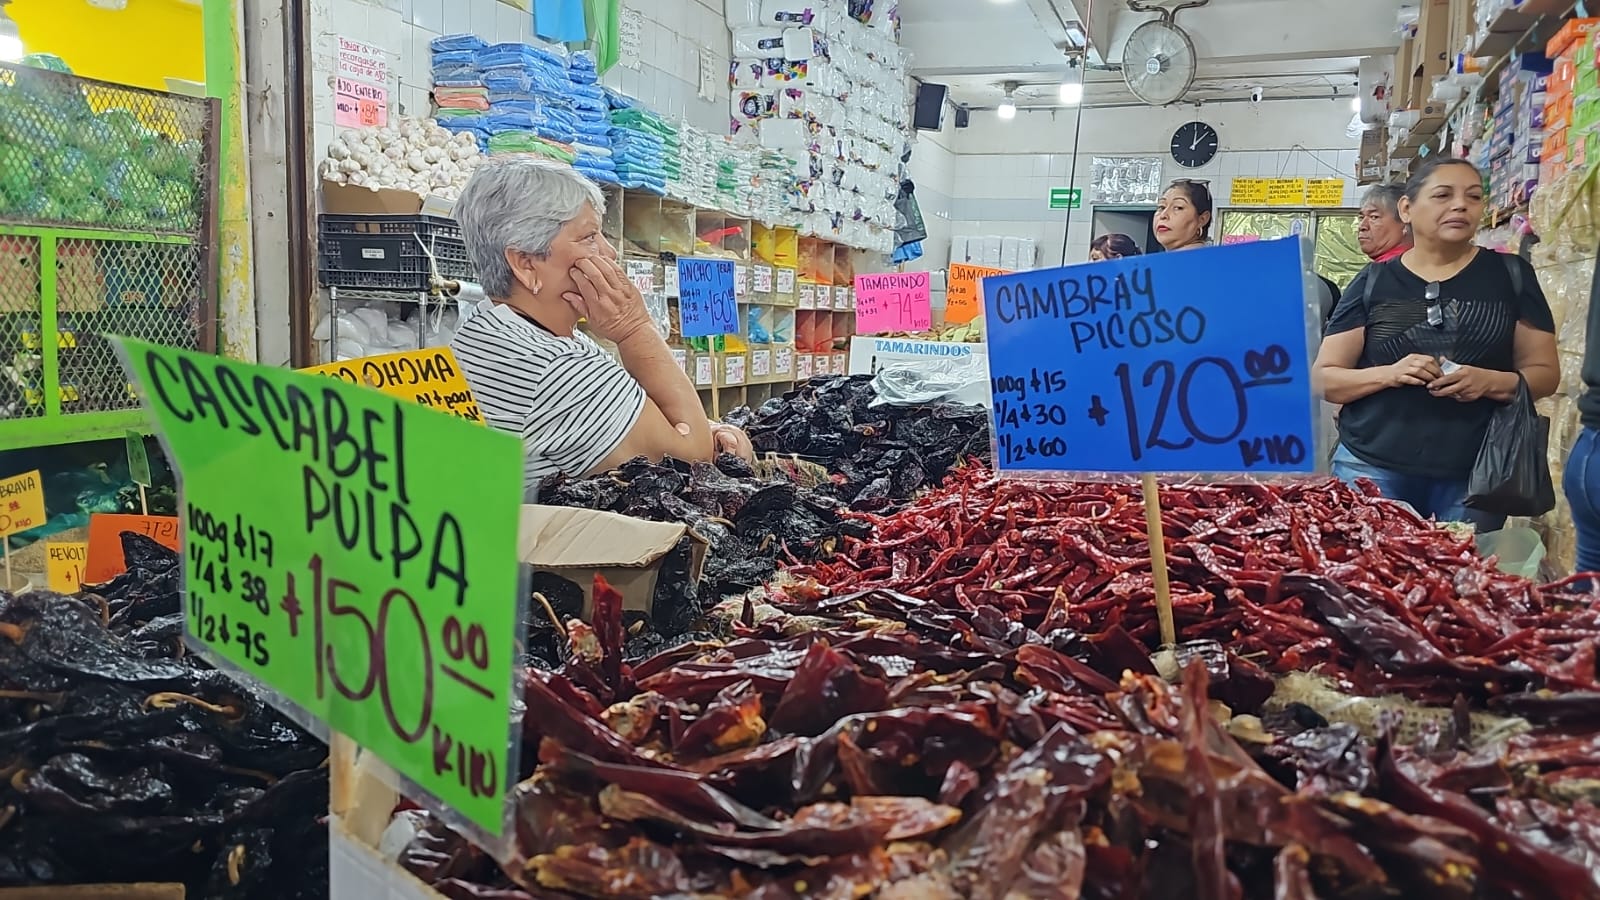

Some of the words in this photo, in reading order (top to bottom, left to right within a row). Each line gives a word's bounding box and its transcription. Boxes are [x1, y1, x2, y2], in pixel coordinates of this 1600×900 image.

[681, 262, 712, 281] ANCHO
[860, 274, 925, 291] TAMARINDO
[996, 267, 1157, 323] CAMBRAY
[875, 340, 971, 357] TAMARINDOS
[1070, 306, 1206, 353] PICOSO
[146, 350, 410, 504] CASCABEL
[188, 502, 228, 563] 100g
[303, 464, 469, 606] PULPA
